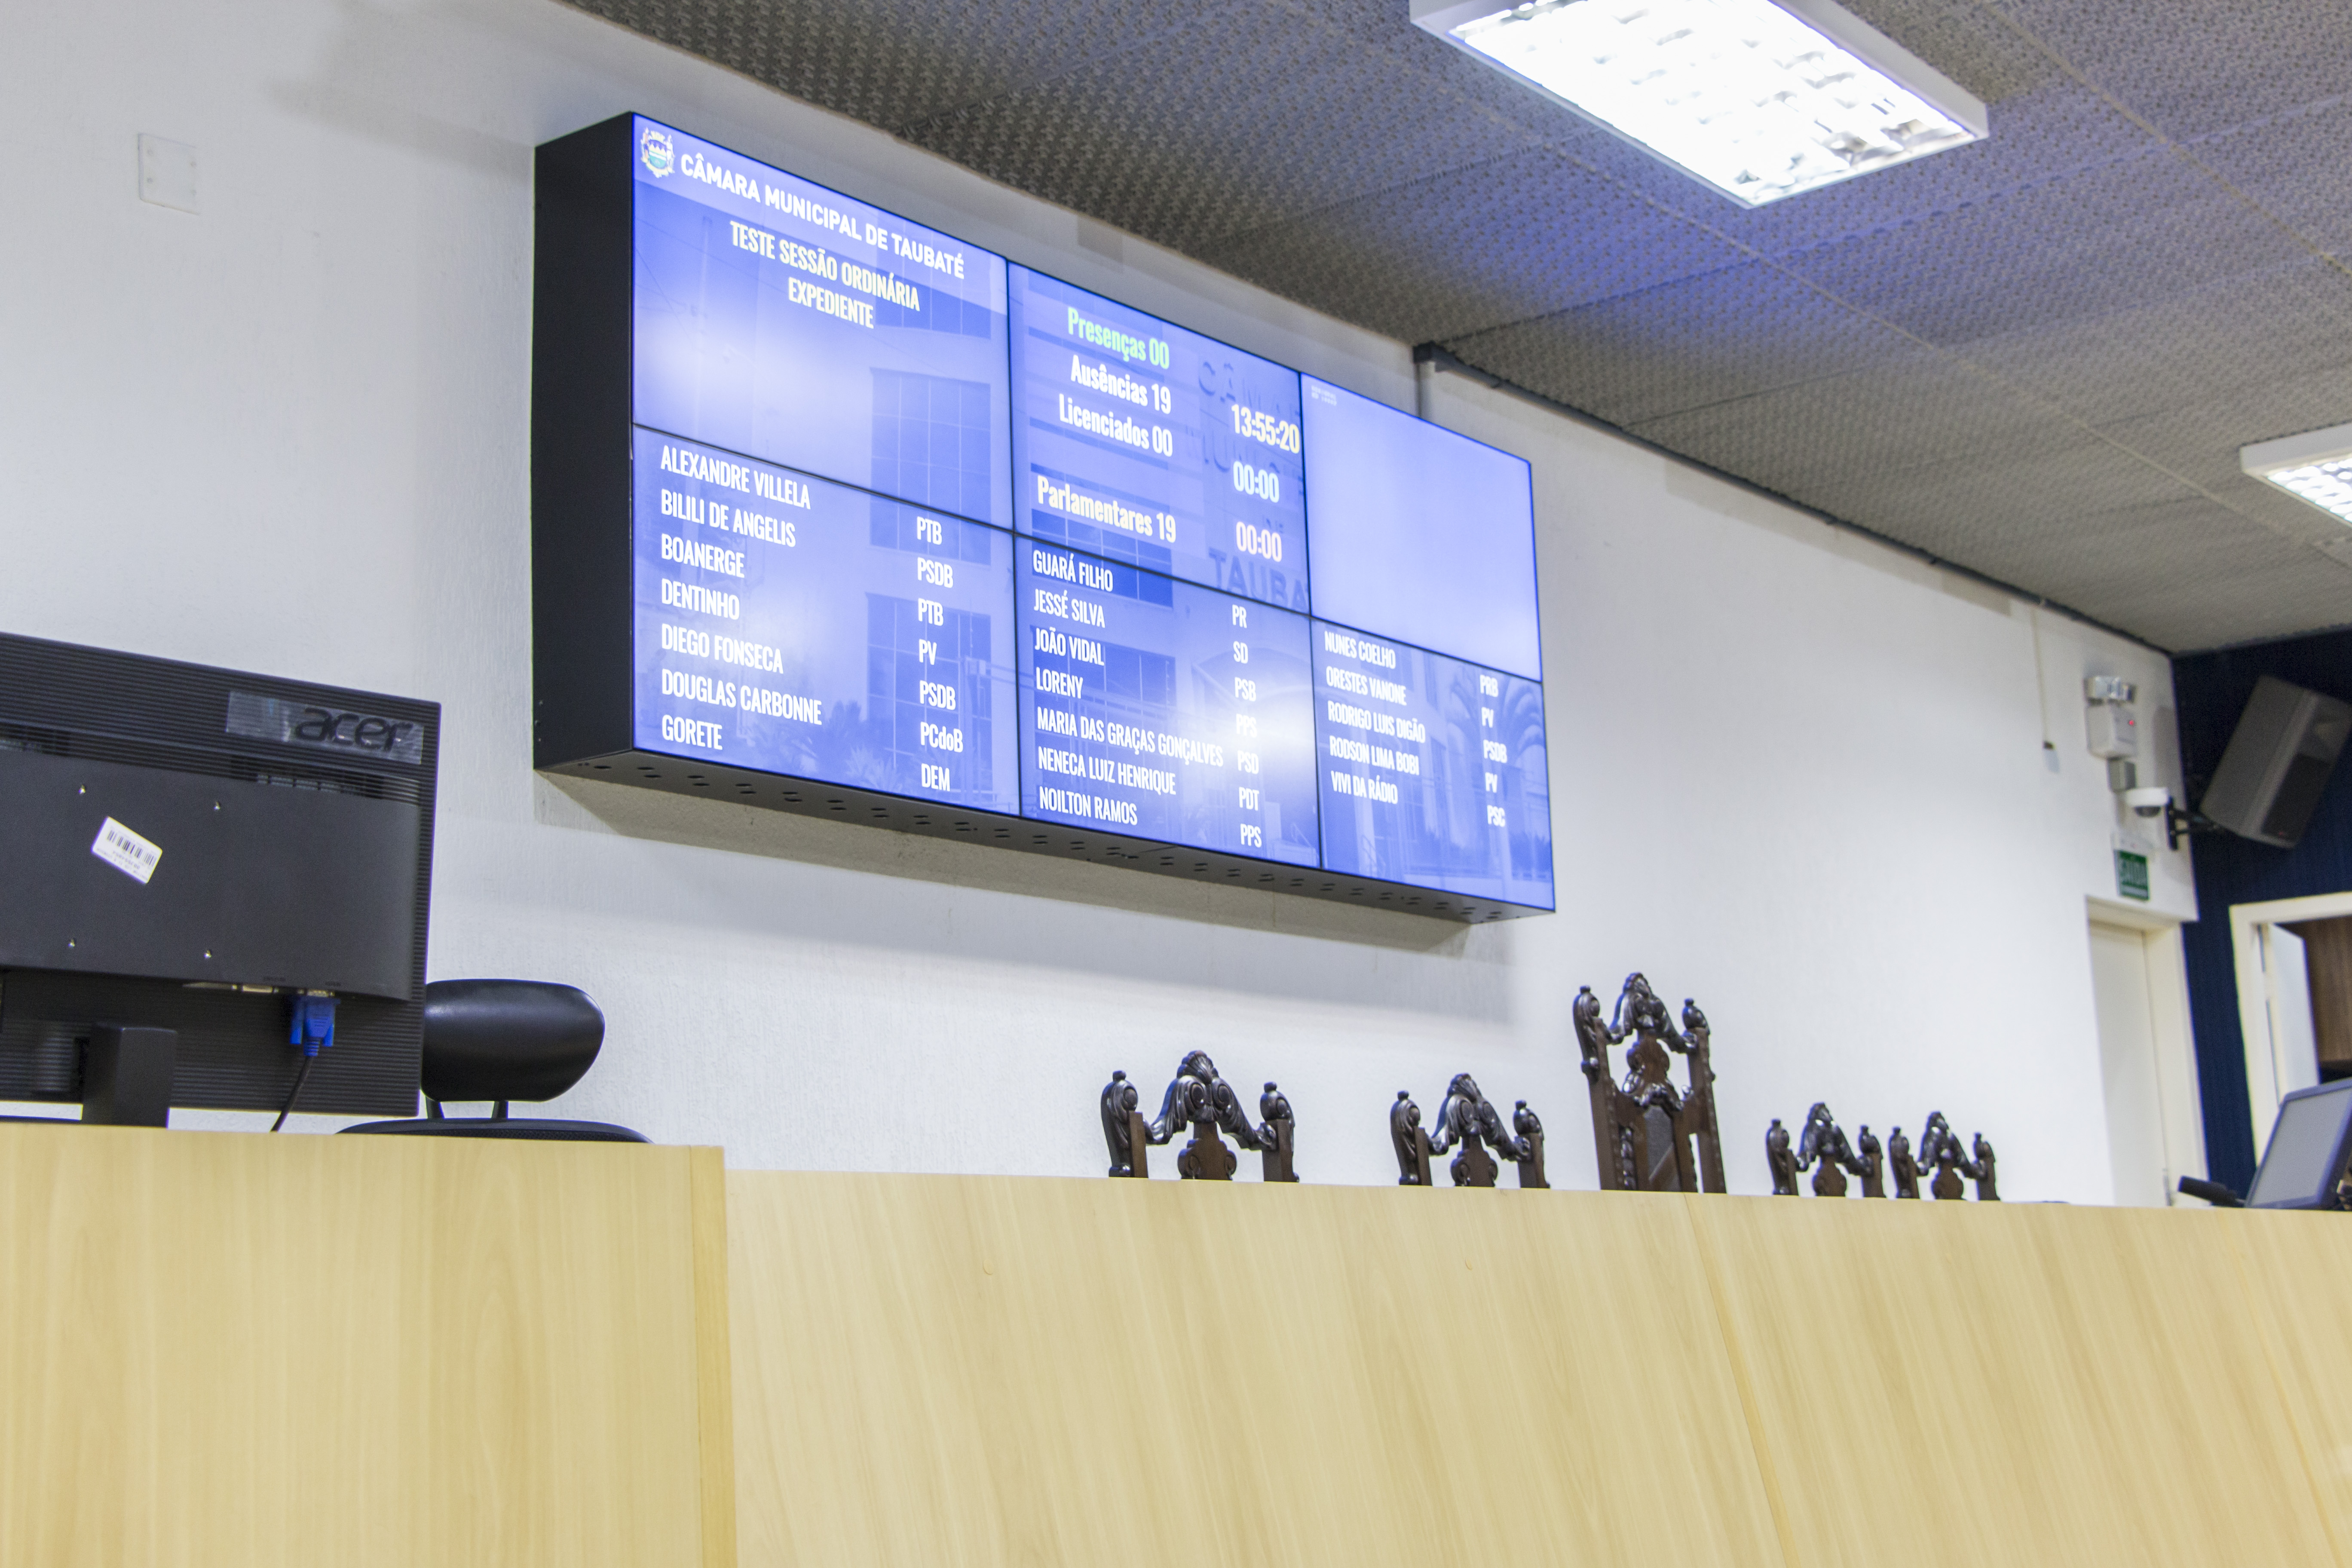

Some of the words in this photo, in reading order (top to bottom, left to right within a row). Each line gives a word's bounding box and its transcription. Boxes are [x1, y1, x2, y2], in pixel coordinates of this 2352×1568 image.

[681, 153, 760, 202] CÂMARA
[765, 184, 861, 242] MUNICIPAL
[866, 224, 887, 251] DE
[891, 232, 964, 279] TAUBATÉ
[730, 220, 775, 260] TESTE
[779, 239, 837, 282] SESSÃO
[842, 263, 920, 312] ORDINÁRIA
[789, 277, 874, 329] EXPEDIENTE
[1068, 307, 1146, 362] Presenças
[1149, 338, 1170, 369] 00
[1070, 355, 1148, 407] Ausências
[1151, 384, 1171, 414] 19
[1059, 393, 1149, 450] Licenciados
[1152, 426, 1173, 457] 00
[1231, 404, 1300, 454] 13:55:20
[661, 445, 750, 494] ALEXANDRE
[754, 471, 811, 510] VILLELA
[1233, 461, 1280, 503] 00:00
[662, 489, 704, 524] BILILI
[710, 501, 729, 530] DE
[733, 508, 796, 548] ANGELIS
[1037, 475, 1153, 537] Parlamentares
[1156, 512, 1176, 543] 19
[917, 516, 942, 545] PTB
[1236, 521, 1282, 562] 00:00
[662, 533, 744, 578] BOANERGE
[917, 557, 954, 588] PSDB
[1033, 550, 1076, 583] GUARÁ
[1079, 561, 1113, 592] FILHO
[662, 578, 740, 620] DENTINHO
[918, 598, 943, 626] PTB
[1034, 589, 1068, 620] JESSÉ
[1072, 598, 1105, 628] SILVA
[1232, 604, 1247, 628] PR
[662, 623, 710, 658] DIEGO
[715, 635, 784, 674] FONSECA
[919, 639, 937, 665] PV
[1035, 627, 1066, 657] JOÃO
[1069, 635, 1104, 666] VIDAL
[1233, 640, 1248, 664] SD
[1324, 631, 1357, 659] NUNES
[1358, 641, 1396, 669] COELHO
[662, 668, 736, 708] DOUGLAS
[741, 685, 822, 726] CARBONNE
[919, 680, 956, 710] PSDB
[1035, 667, 1083, 699] LORENY
[1234, 677, 1256, 702] PSB
[1326, 666, 1368, 696] ORESTES
[1369, 677, 1406, 706] VANONE
[1480, 674, 1498, 698] PRB
[296, 707, 413, 752] acer
[662, 714, 723, 750] GORETE
[920, 721, 964, 753] PCdoB
[1037, 706, 1078, 737] MARIA
[1081, 717, 1105, 743] DAS
[1107, 722, 1155, 756] GRAÇAS
[1158, 733, 1223, 767] GONÇALVES
[1236, 714, 1257, 738] PPS
[1328, 700, 1372, 731] RODRIGO
[1373, 712, 1394, 737] LUIS
[1396, 718, 1425, 744] DIGÃO
[1481, 707, 1494, 729] PV
[1038, 746, 1086, 778] NENECA
[1088, 757, 1115, 784] LUIZ
[1117, 763, 1176, 795] HENRIQUE
[1237, 750, 1259, 775] PSD
[1329, 735, 1370, 764] RODSON
[1371, 747, 1395, 771] LIMA
[1396, 752, 1419, 776] BOBI
[1483, 740, 1507, 764] PSDB
[921, 763, 950, 792] DEM
[1331, 771, 1351, 795] VIVI
[1353, 776, 1367, 798] DA
[1368, 775, 1398, 805] RÁDIO
[1485, 772, 1497, 793] PV
[1039, 786, 1091, 818] NOILTON
[1094, 796, 1138, 825] RAMOS
[1238, 787, 1259, 812] PDT
[1487, 805, 1505, 827] PSC
[1240, 824, 1262, 848] PPS
